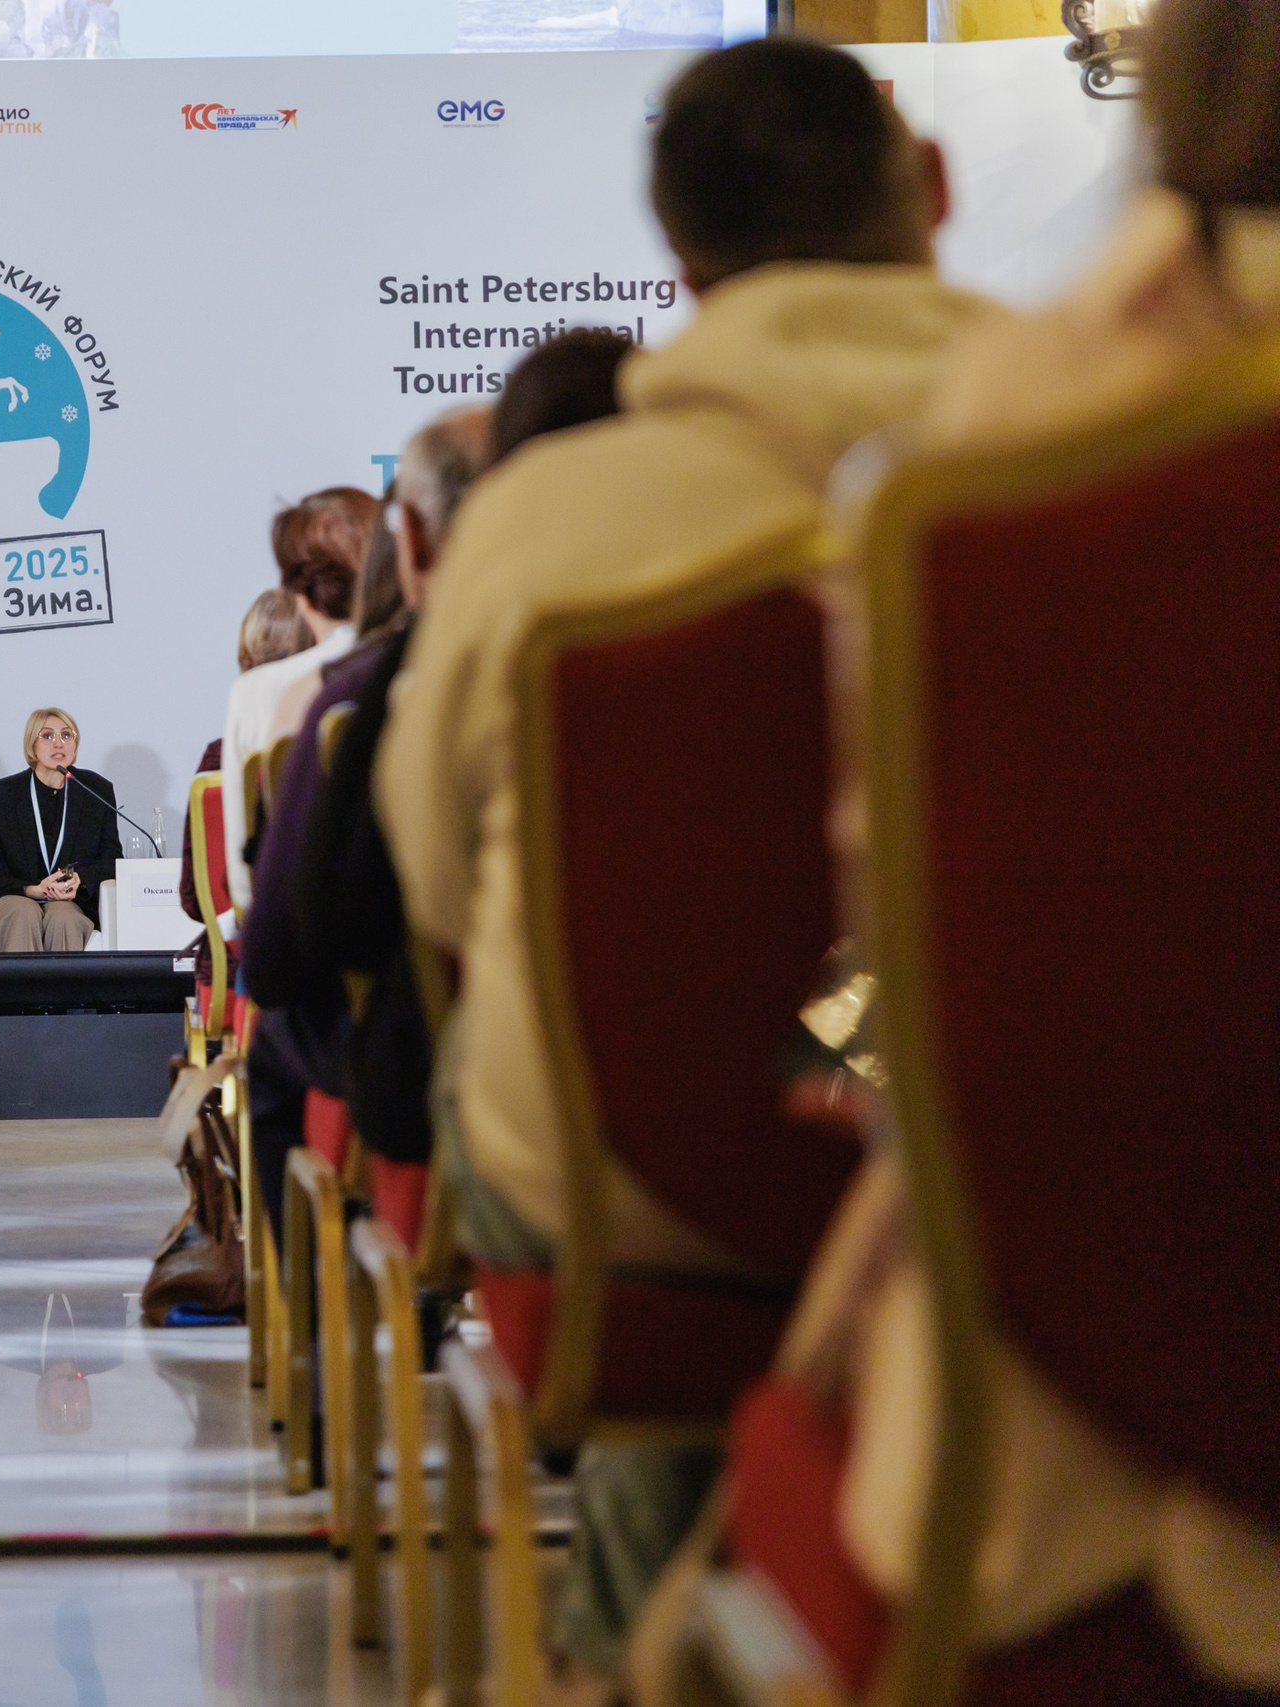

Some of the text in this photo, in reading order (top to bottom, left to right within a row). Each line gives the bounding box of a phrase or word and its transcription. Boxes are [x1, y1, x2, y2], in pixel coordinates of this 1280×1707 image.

[379, 272, 677, 309] Saint Petersburg
[64, 315, 120, 412] ФОРУМ
[393, 364, 514, 394] Touris
[4, 545, 100, 582] 2025.
[3, 587, 103, 617] Зима.
